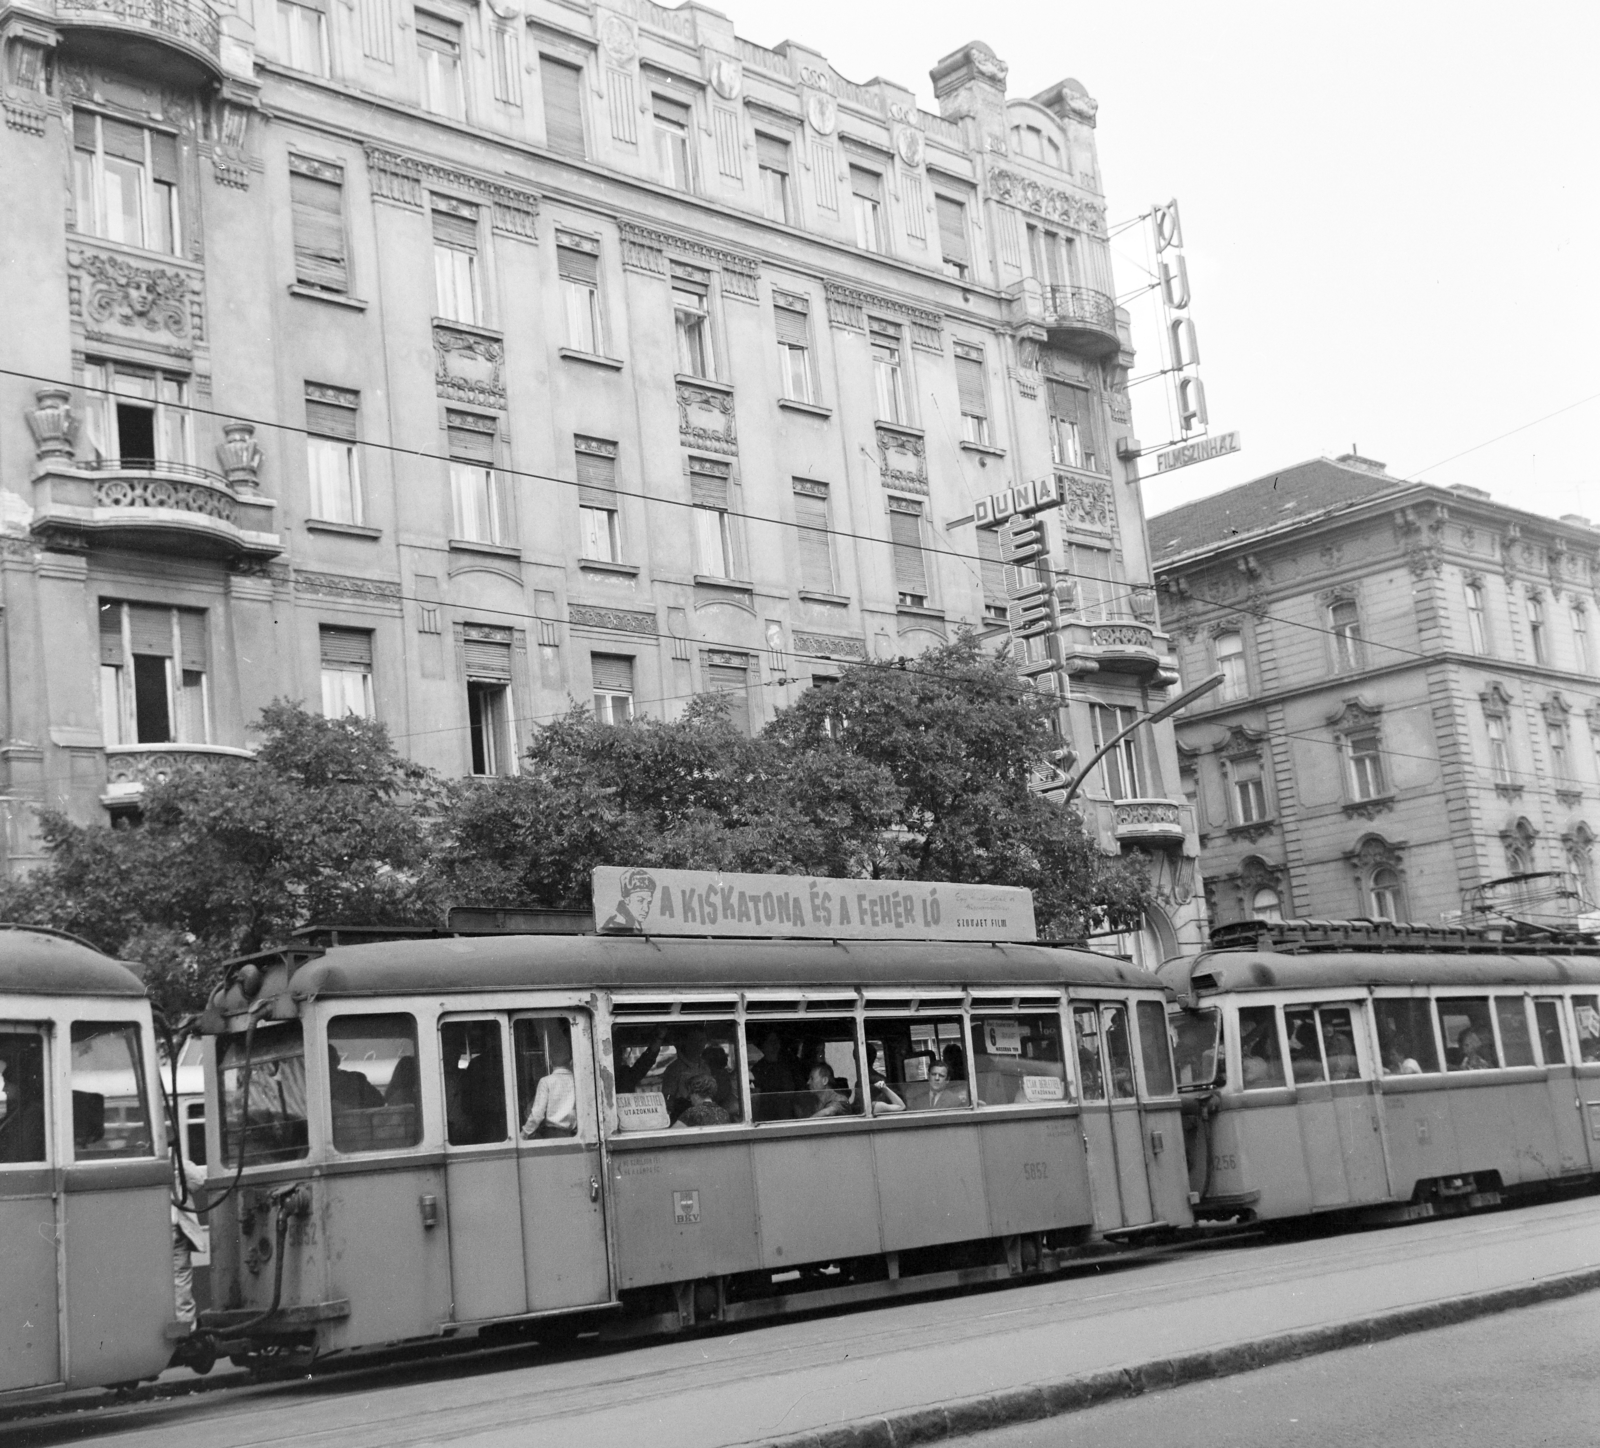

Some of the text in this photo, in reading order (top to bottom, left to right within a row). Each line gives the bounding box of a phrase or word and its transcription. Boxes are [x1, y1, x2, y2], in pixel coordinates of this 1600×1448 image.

[975, 480, 1051, 522] DUNA
[660, 880, 941, 929] A KISKATONA ÉS A FEHÉR LÓ
[991, 918, 1007, 928] FILM
[989, 1027, 997, 1047] 6
[1023, 1161, 1049, 1180] 5852
[676, 1213, 700, 1223] BKV
